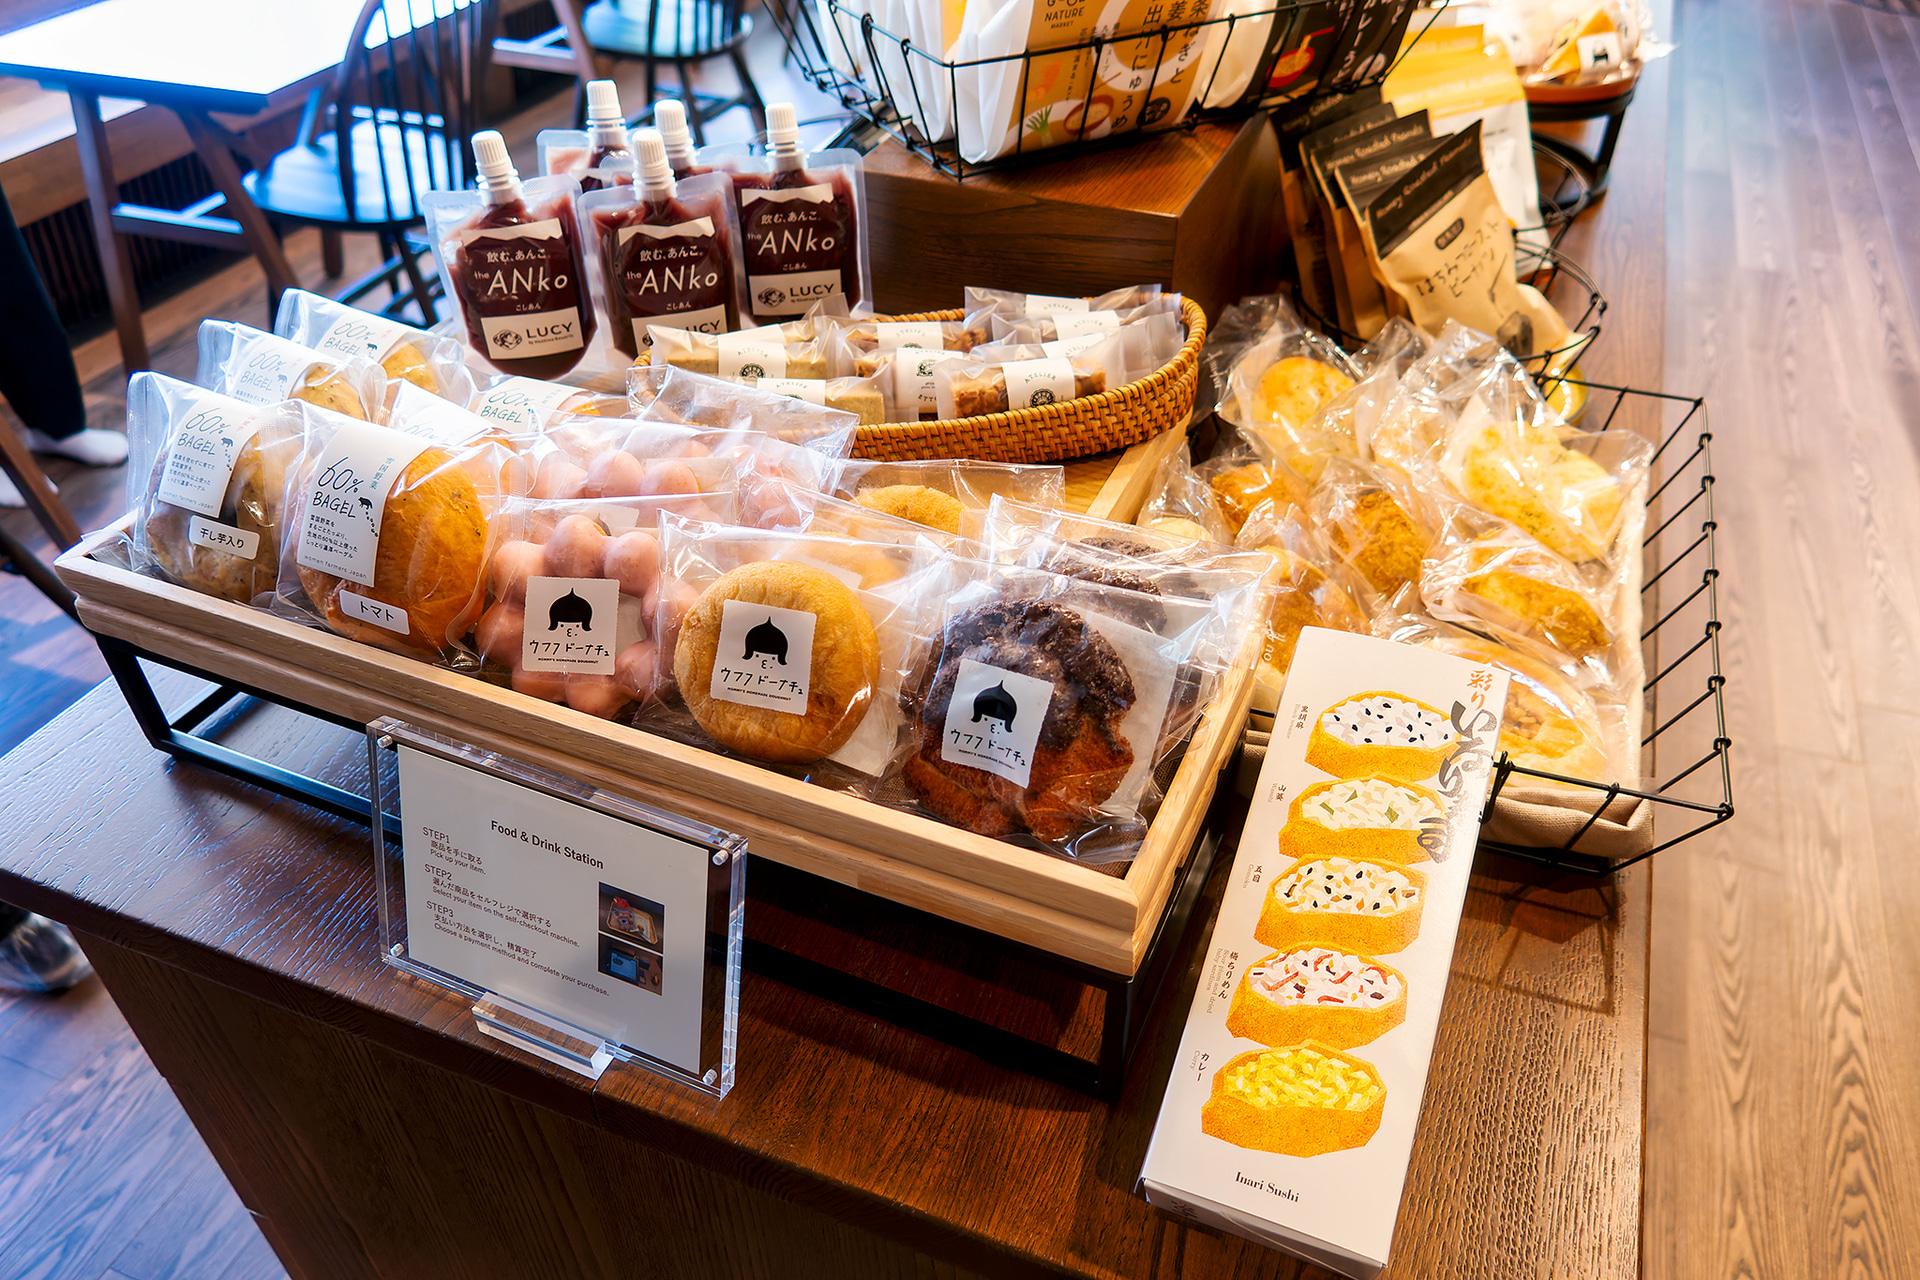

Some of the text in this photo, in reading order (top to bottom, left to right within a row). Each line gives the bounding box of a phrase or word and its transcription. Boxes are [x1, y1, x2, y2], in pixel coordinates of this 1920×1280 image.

[1044, 6, 1085, 22] NATURE
[747, 227, 835, 256] the ANko
[782, 262, 807, 272] こしあん
[474, 266, 568, 296] the ANko
[626, 264, 718, 296] the ANko
[790, 283, 835, 297] LUCY
[516, 303, 541, 311] こしあん
[666, 301, 692, 311] こしあん
[334, 318, 375, 340] 60%
[526, 322, 573, 338] LUCY
[685, 320, 720, 334] UCY
[324, 337, 360, 356] BAGEL
[249, 347, 287, 372] 60%
[240, 371, 273, 392] BAGEL
[1024, 372, 1057, 384] ATELIER
[488, 387, 534, 407] 60%
[186, 408, 232, 435] 60%
[480, 406, 522, 424] BAGEL
[177, 433, 216, 456] BAGEL
[318, 456, 366, 494] 60%
[312, 490, 357, 519] BAGEL
[200, 527, 246, 549] 干し芋入り
[360, 601, 395, 622] トマト
[529, 640, 561, 655] ウフフ
[721, 667, 753, 686] ウフフ
[727, 687, 792, 701] MOMMY'S HOMEMADE DOUGHNUT
[951, 728, 983, 749] ウフフ
[422, 827, 450, 844] STEP1
[491, 820, 604, 869] Food & Drink Station
[430, 840, 483, 865] 商品を手に取る
[430, 849, 444, 860] Pick
[454, 859, 468, 868] your
[424, 863, 452, 881] STEP2
[1252, 865, 1263, 883] 五目
[426, 900, 454, 918] STEP3
[432, 886, 452, 899] Select
[453, 895, 467, 905] your
[468, 900, 482, 910] item
[493, 909, 504, 919] the
[504, 914, 549, 936] self-checkout
[549, 931, 580, 947] machine.
[434, 922, 457, 936] Choose
[463, 935, 491, 952] payment
[491, 944, 516, 960] method
[517, 954, 529, 965] and
[530, 961, 560, 977] complete
[561, 973, 576, 984] your
[577, 979, 610, 997] purchase.
[1190, 1050, 1201, 1071] Curry
[1197, 1052, 1210, 1082] カレー
[1235, 1171, 1300, 1203] Inari Sushi
